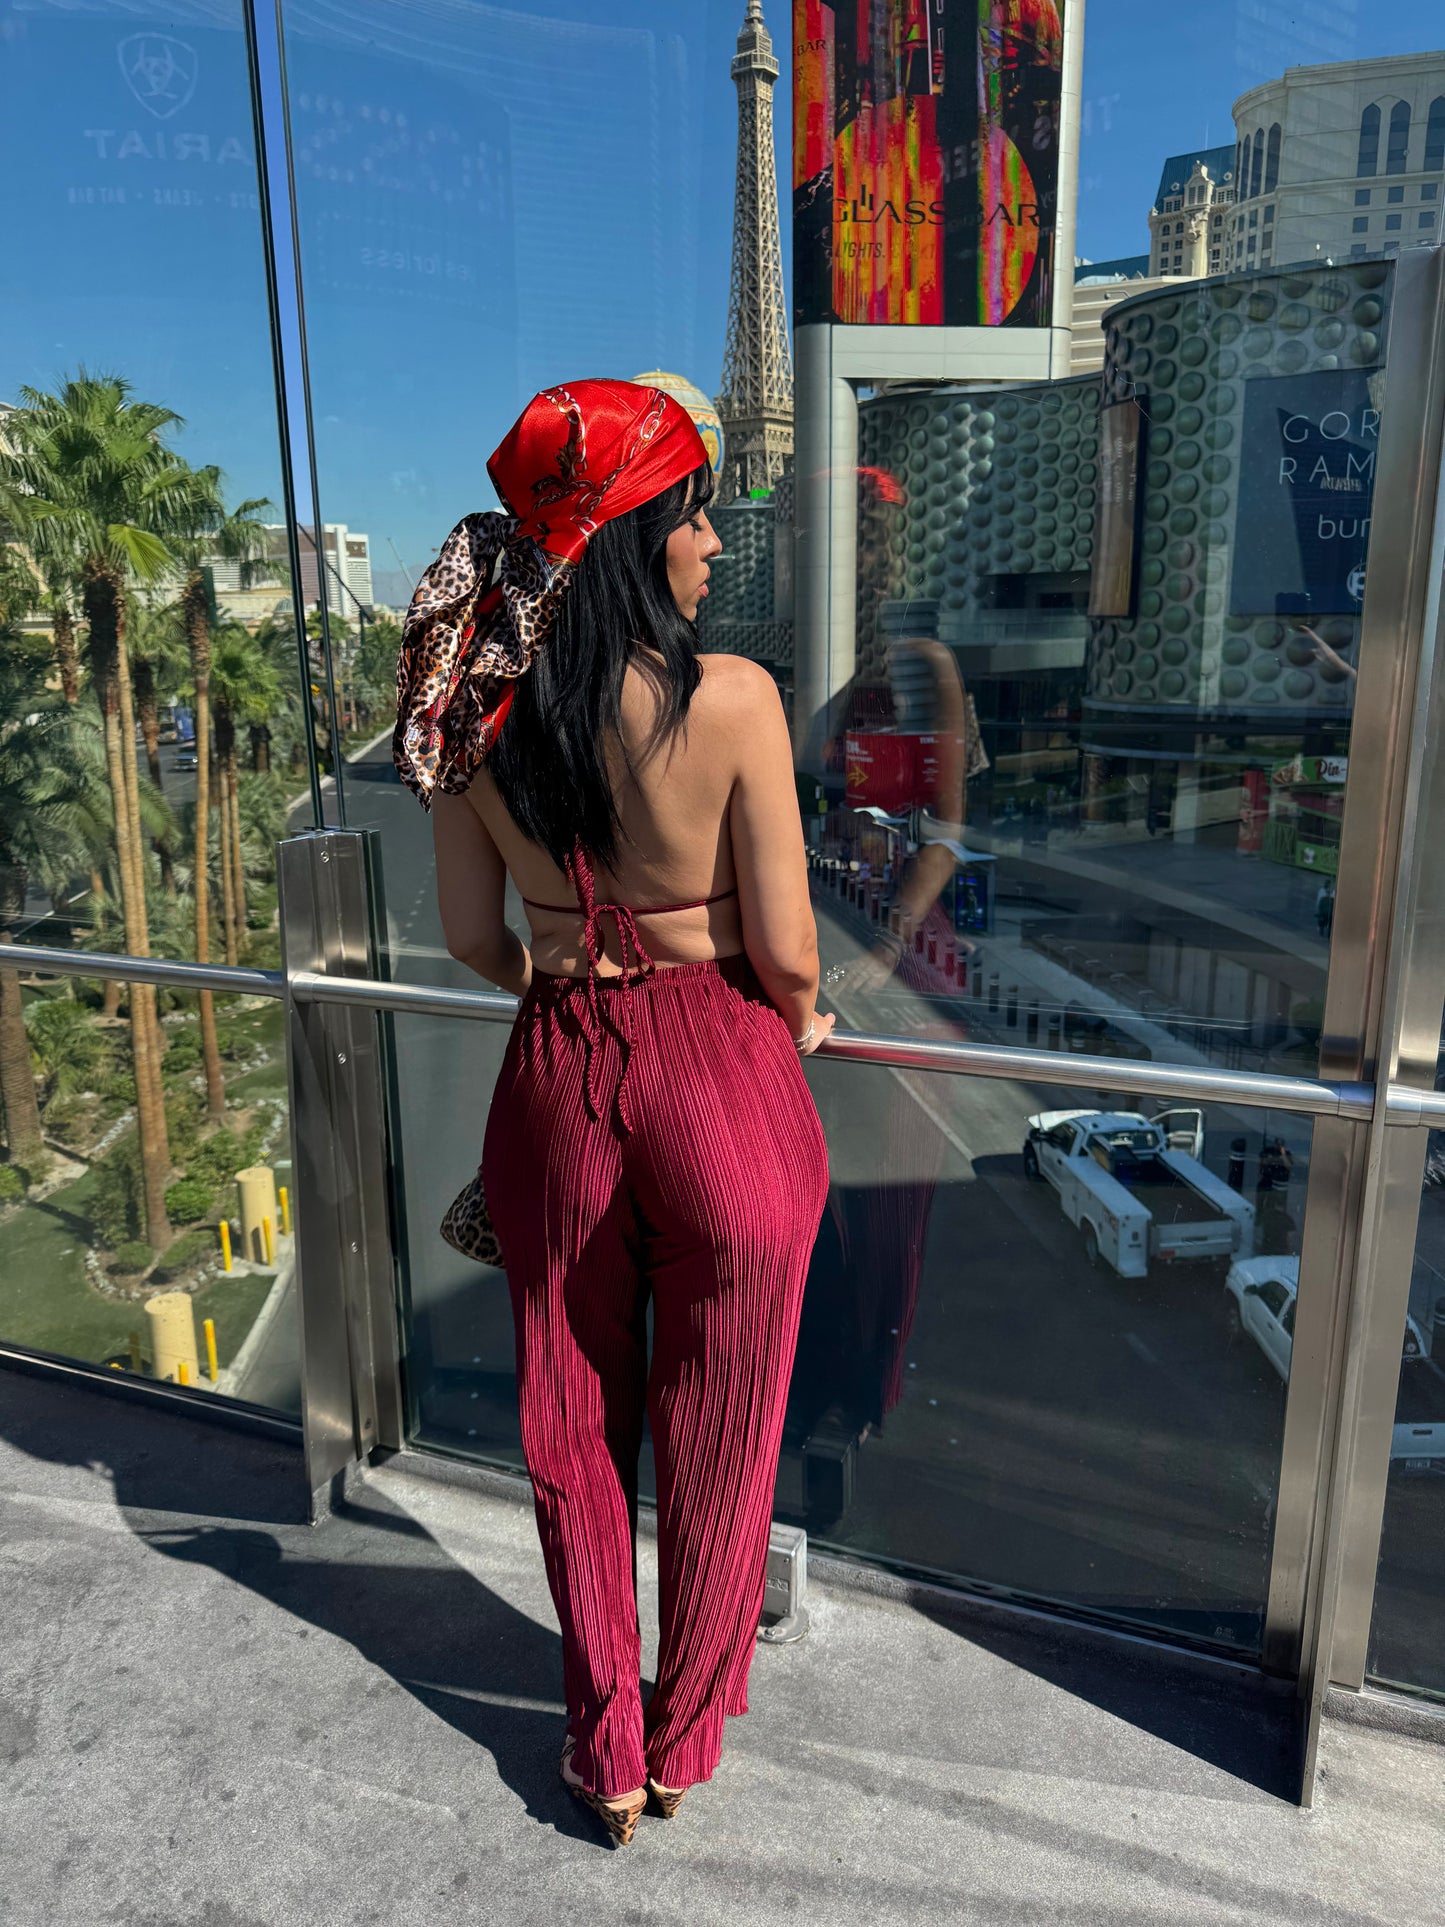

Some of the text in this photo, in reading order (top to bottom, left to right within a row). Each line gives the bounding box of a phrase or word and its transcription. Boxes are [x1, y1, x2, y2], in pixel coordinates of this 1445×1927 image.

[832, 198, 945, 226] GLASS
[1283, 409, 1380, 443] GOR
[1279, 451, 1375, 485] RAM
